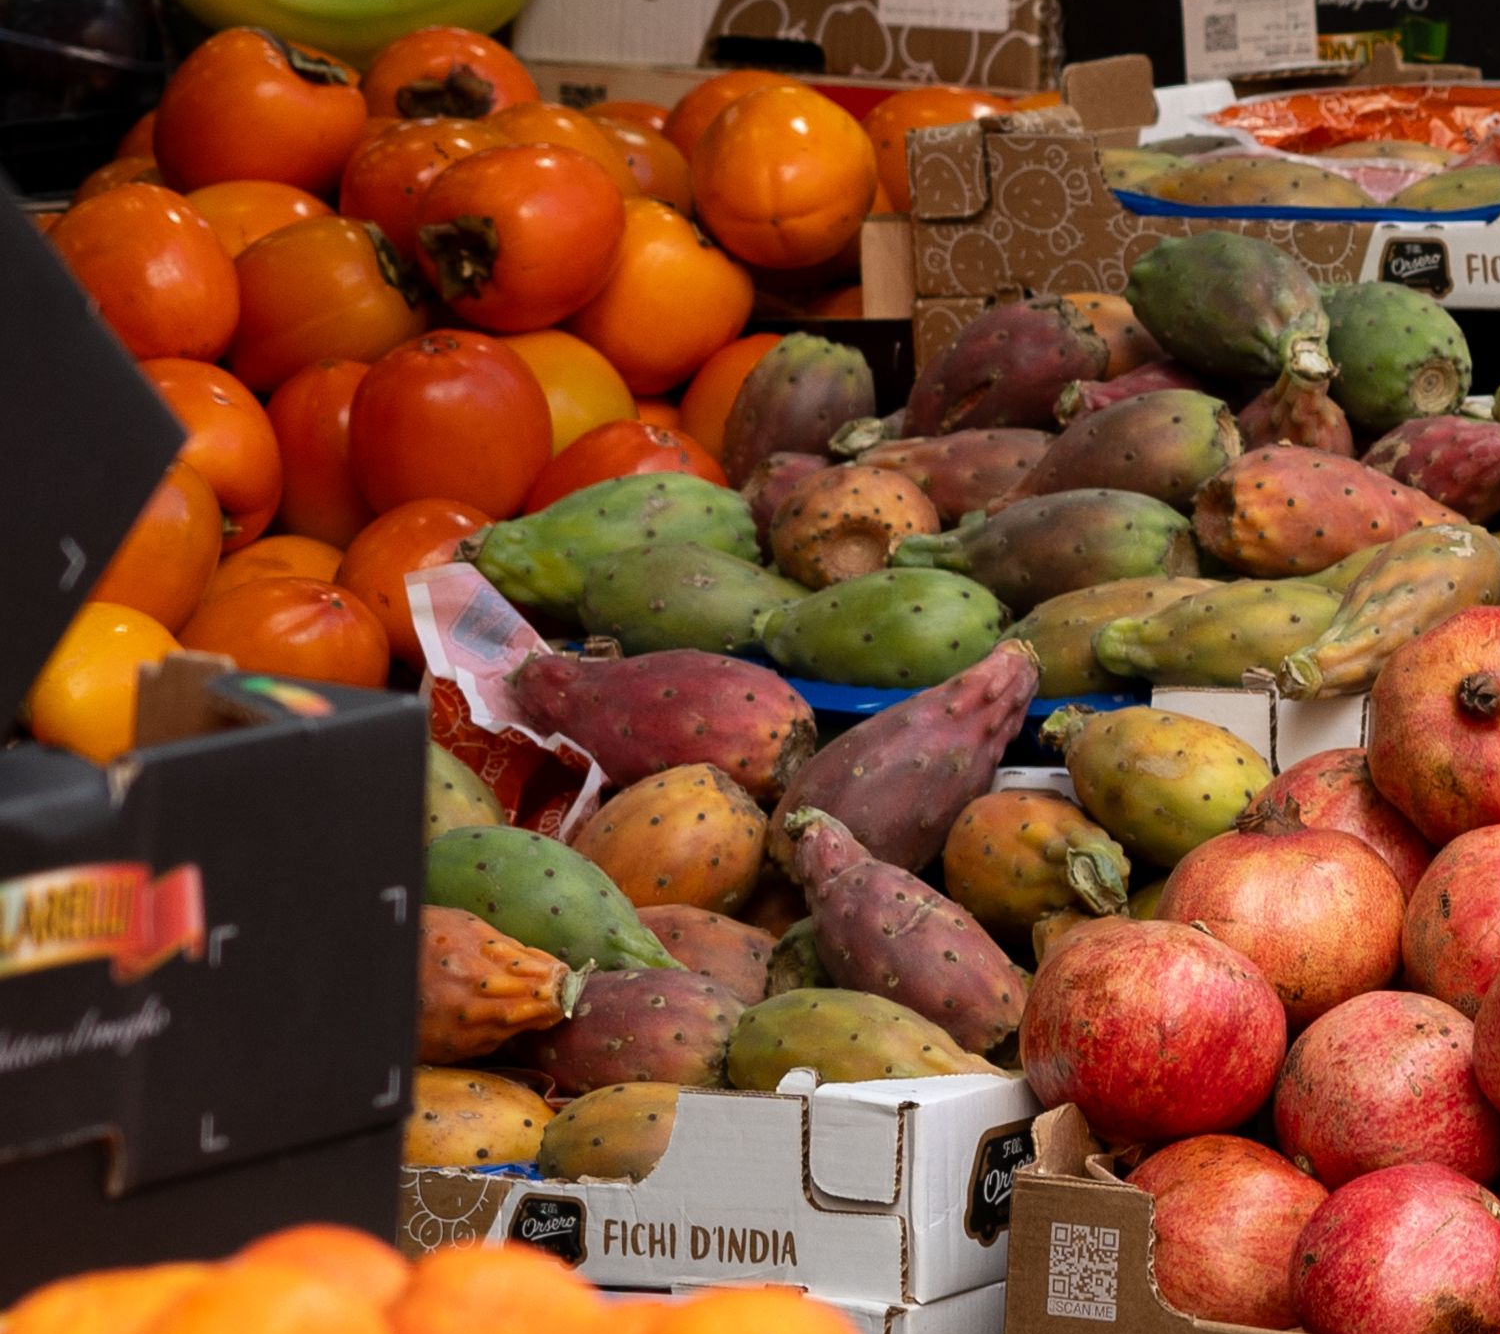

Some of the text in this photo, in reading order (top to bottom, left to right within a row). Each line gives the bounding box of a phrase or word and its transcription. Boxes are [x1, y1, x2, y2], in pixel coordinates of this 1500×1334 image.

[1391, 254, 1442, 276] Orsero
[522, 1216, 576, 1238] Orsero
[603, 1219, 798, 1267] FICHI D'INDIA
[1056, 1300, 1114, 1318] SCAN ME
